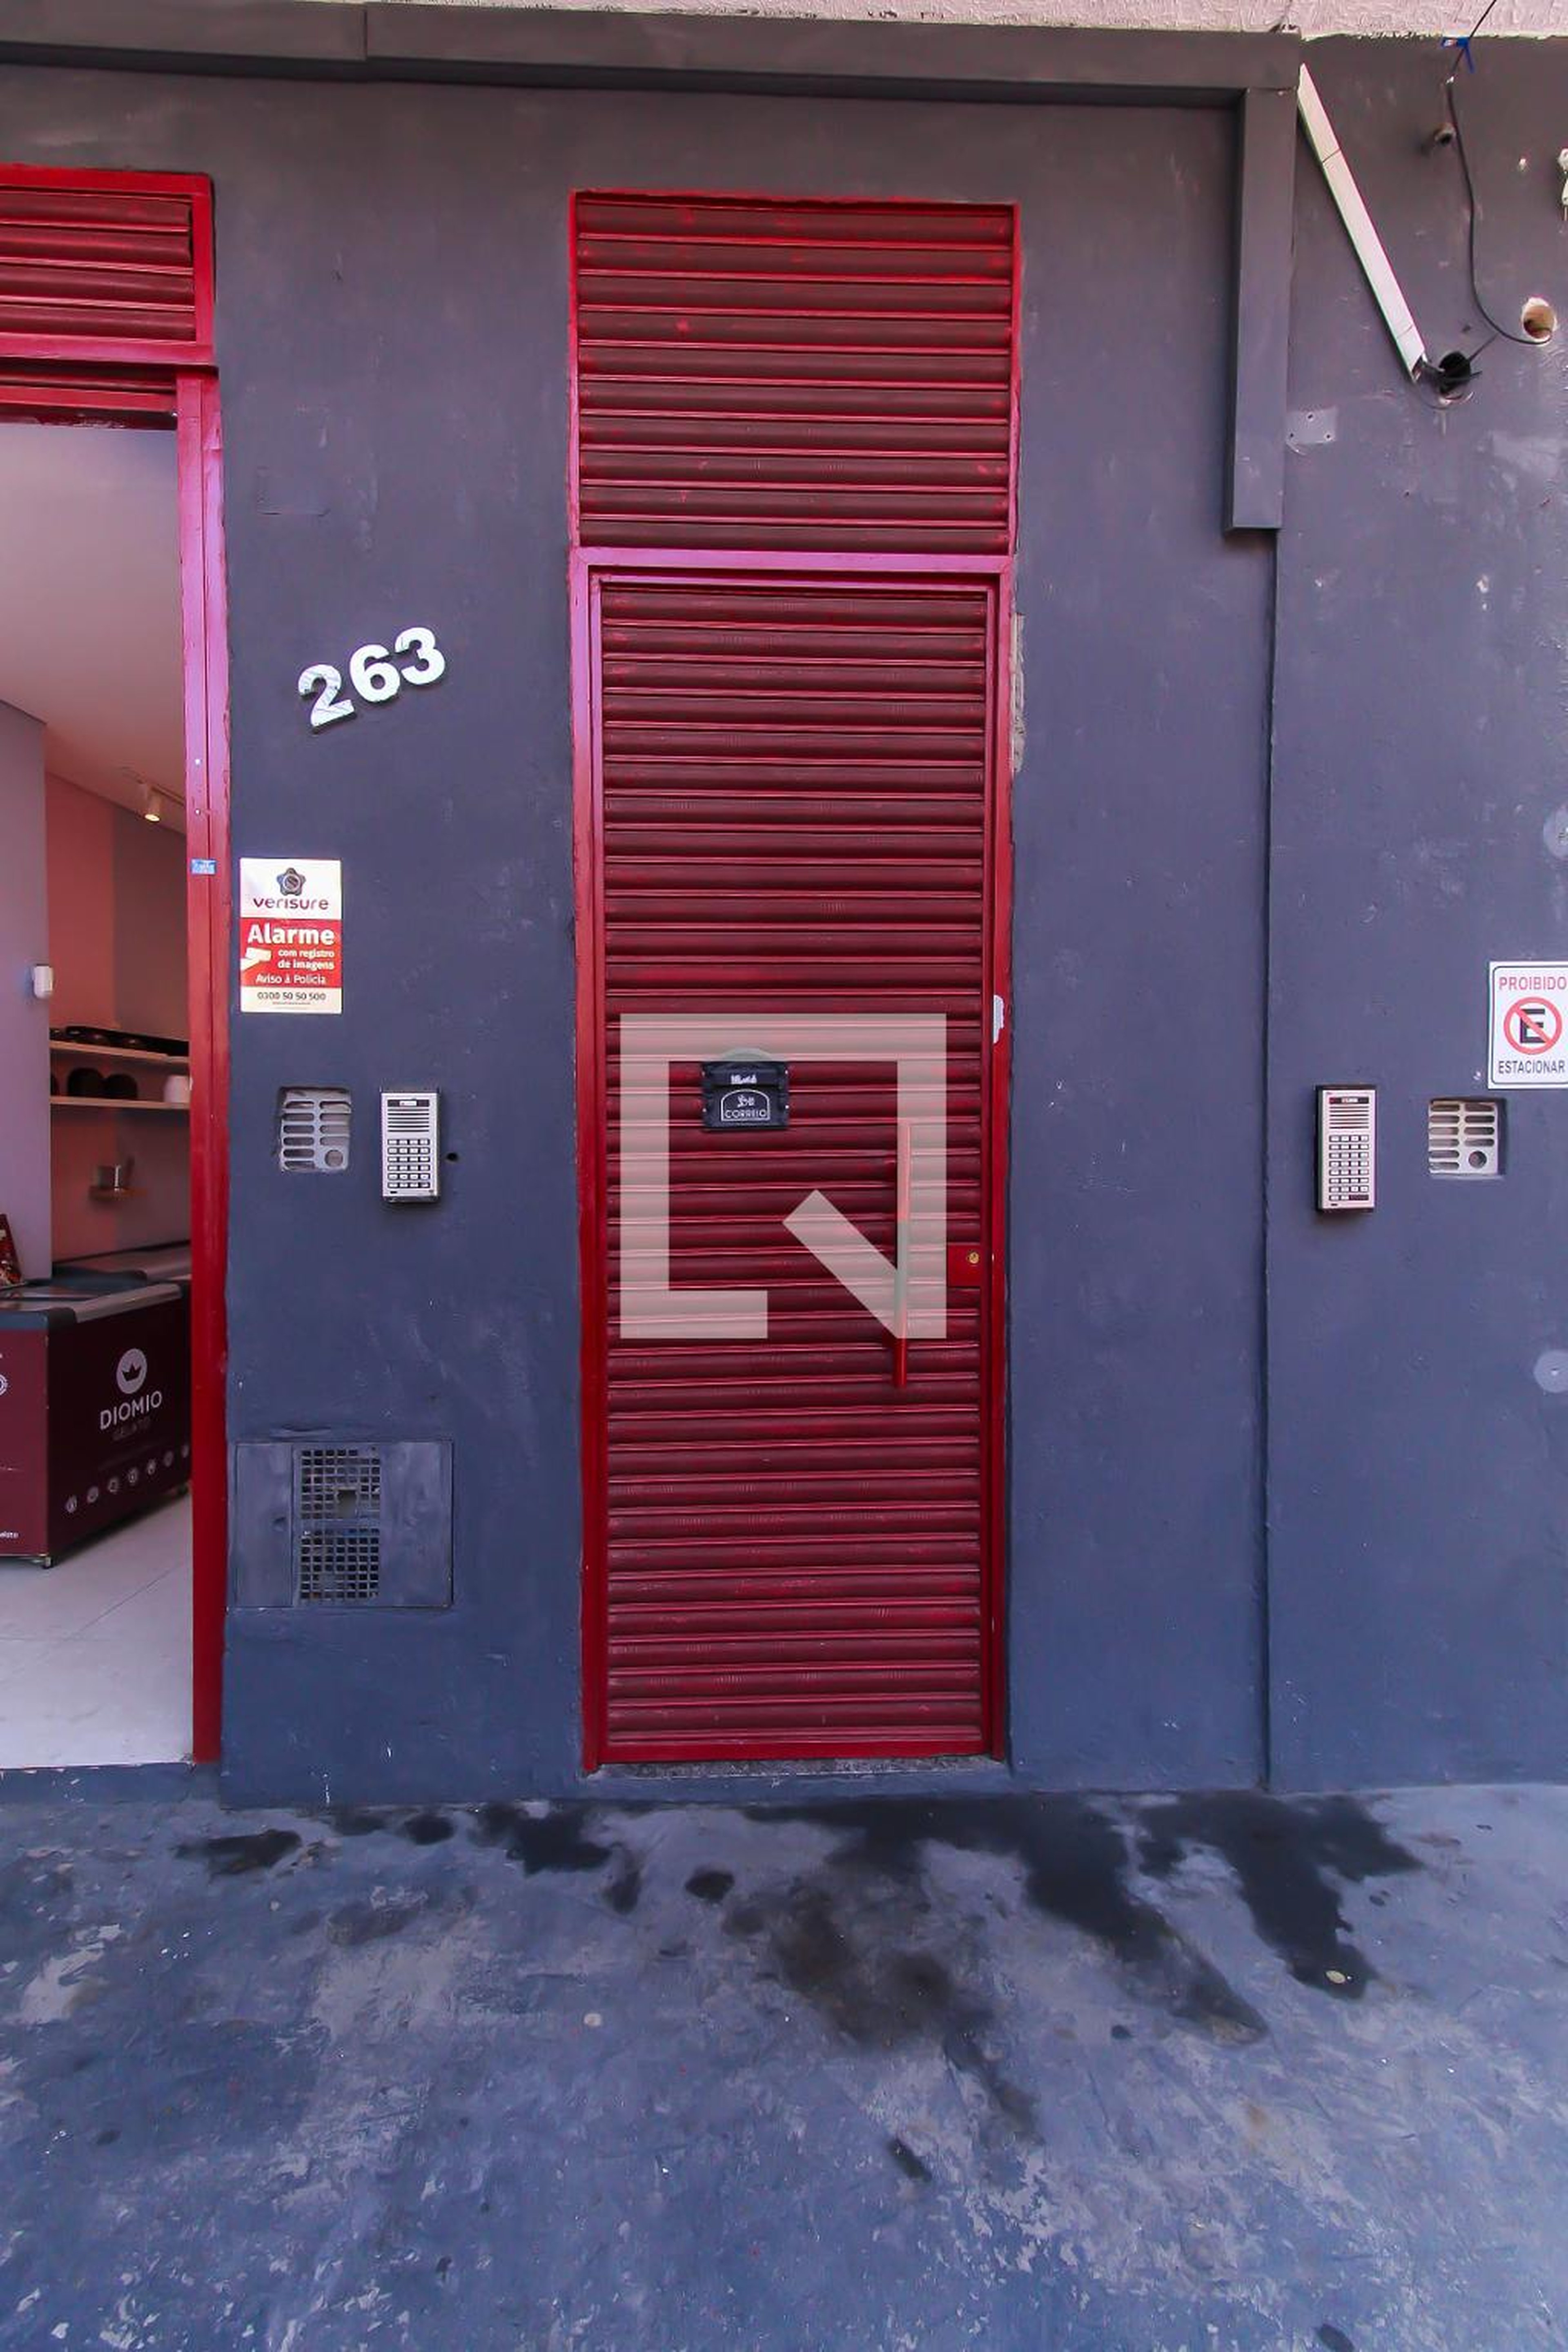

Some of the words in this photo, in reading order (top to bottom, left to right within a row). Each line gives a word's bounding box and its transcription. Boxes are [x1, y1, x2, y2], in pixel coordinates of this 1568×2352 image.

[298, 627, 445, 726] 263
[253, 898, 328, 910] verisure
[247, 923, 335, 945] Alarme
[299, 949, 334, 960] registro
[278, 960, 291, 968] de
[293, 959, 334, 971] imagens
[256, 973, 282, 984] Aviso
[1499, 976, 1567, 990] PROIBIDO
[1499, 1060, 1565, 1074] ESTACIONAR
[100, 1390, 163, 1430] DIOMIO
